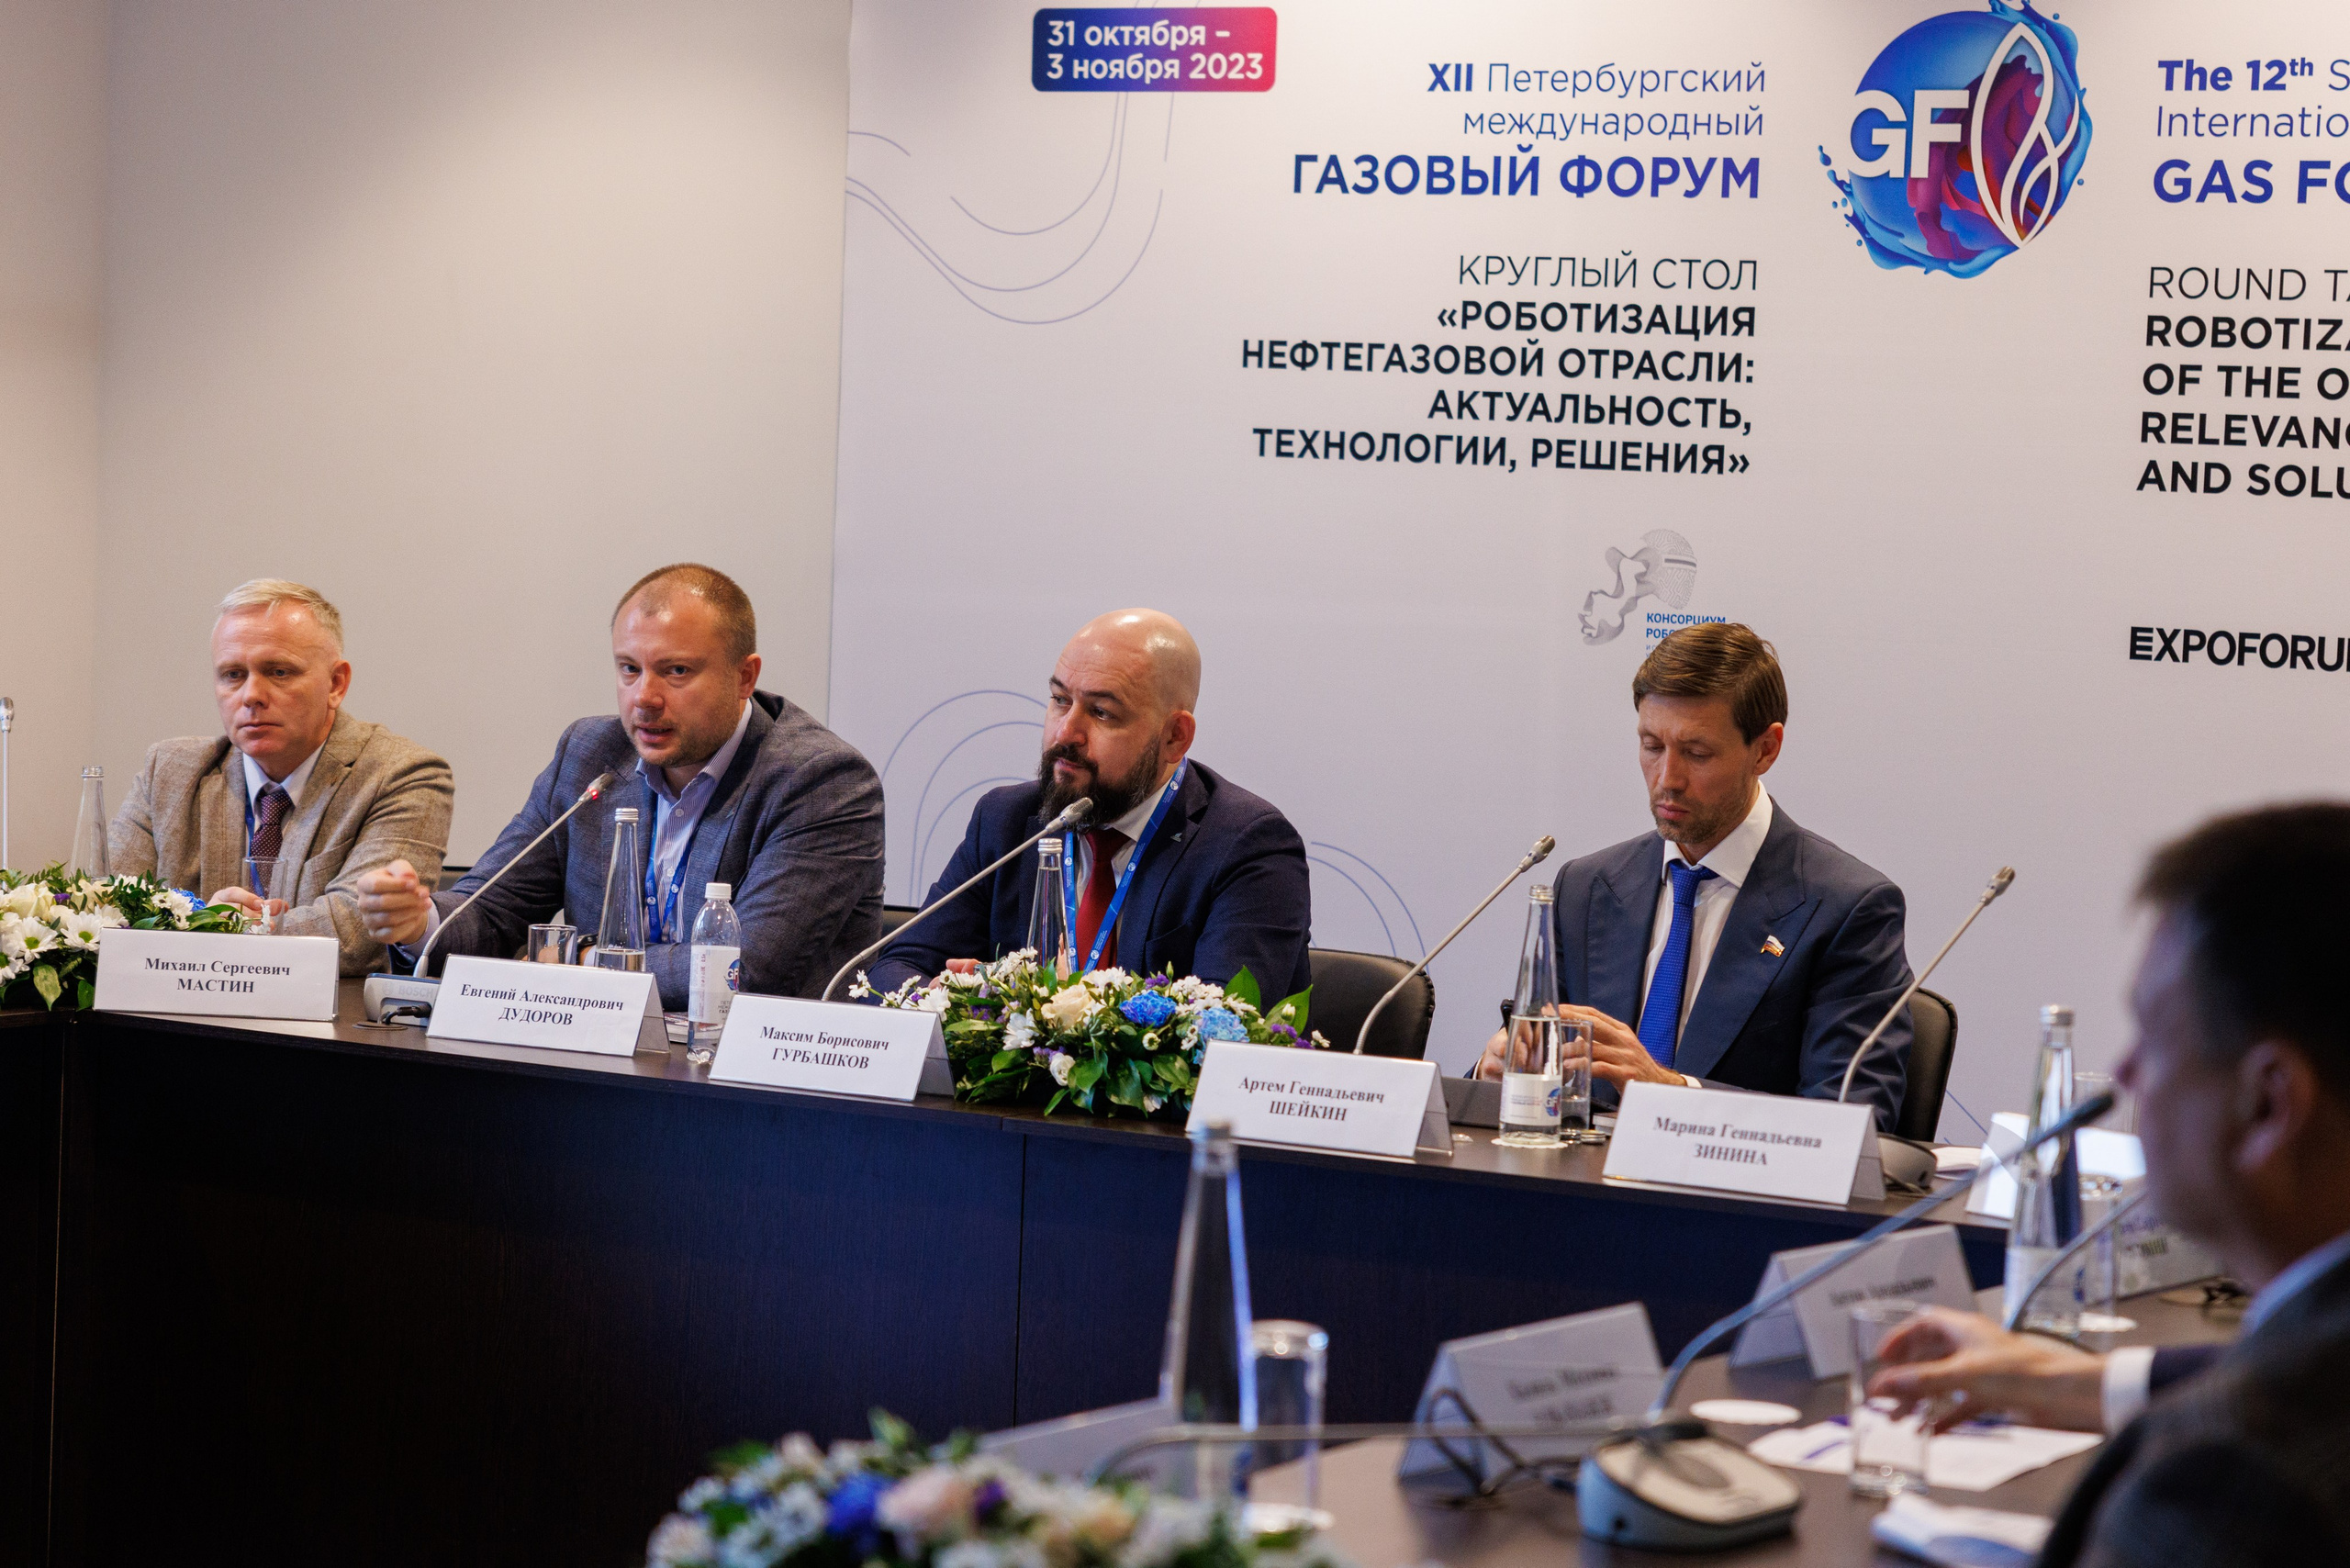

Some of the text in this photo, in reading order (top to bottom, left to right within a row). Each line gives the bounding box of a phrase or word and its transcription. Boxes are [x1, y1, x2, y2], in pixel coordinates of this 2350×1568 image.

[1048, 21, 1074, 45] 31
[1084, 20, 1206, 50] октября
[1047, 53, 1262, 84] 3 ноября 2023
[1427, 62, 1764, 98] XII Петербургский
[2158, 59, 2232, 91] The
[2246, 58, 2313, 91] 12th
[1464, 106, 1762, 141] международный
[1840, 89, 1970, 178] GF
[2157, 106, 2350, 137] Internatio
[1294, 144, 1759, 198] ГАЗОВЫЙ ФОРУМ
[2154, 159, 2273, 204] GAS
[1460, 251, 1757, 290] КРУГЛЫЙ СТОЛ
[2150, 267, 2350, 301] ROUND T
[1437, 301, 1756, 342] «РОБОТИЗАЦИЯ
[2146, 315, 2350, 351] ROBOTIZ
[1243, 339, 1753, 383] НЕФТЕГАЗОВОЙ ОТРАСЛИ:
[2143, 364, 2202, 396] OF
[2218, 365, 2300, 398] THE
[1428, 390, 1752, 435] АКТУАЛЬНОСТЬ,
[2141, 411, 2350, 449] RELEVAN
[1253, 429, 1750, 475] ТЕХНОЛОГИИ, РЕШЕНИЯ»
[2136, 460, 2231, 494] AND
[1646, 612, 1726, 624] КОНСОРЦИУМ
[2130, 626, 2350, 672] EXPOFORU
[145, 958, 291, 977] Михаил Сергеевич
[177, 979, 254, 993] МАСТИН
[460, 984, 624, 1011] Евгений Александрович
[498, 1007, 573, 1025] ДУДОРОВ
[760, 1026, 890, 1051] Максим Борисович
[772, 1047, 870, 1069] ГУРБАШКОВ
[1238, 1077, 1385, 1103] Артем Геннадьевич
[1269, 1101, 1348, 1122] ШЕЙКИН
[1653, 1116, 1822, 1148] Марина Геннадьевна
[1694, 1144, 1768, 1166] ЗИНИНА
